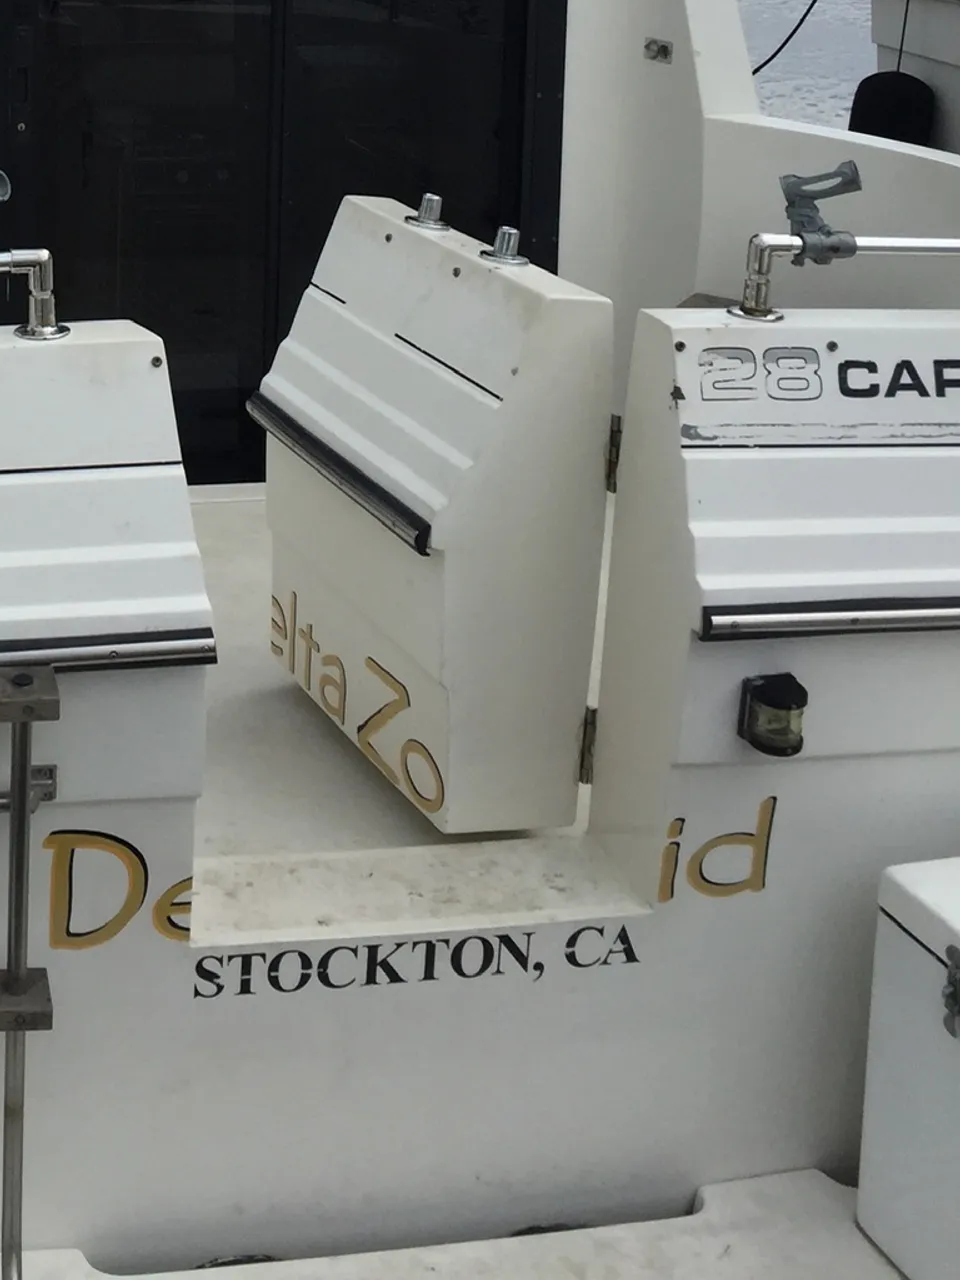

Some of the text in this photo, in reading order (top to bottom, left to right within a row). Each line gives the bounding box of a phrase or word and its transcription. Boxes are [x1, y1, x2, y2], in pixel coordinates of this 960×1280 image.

[697, 346, 823, 401] 28
[655, 795, 778, 904] id
[192, 922, 642, 1000] STOCKTON, CA
